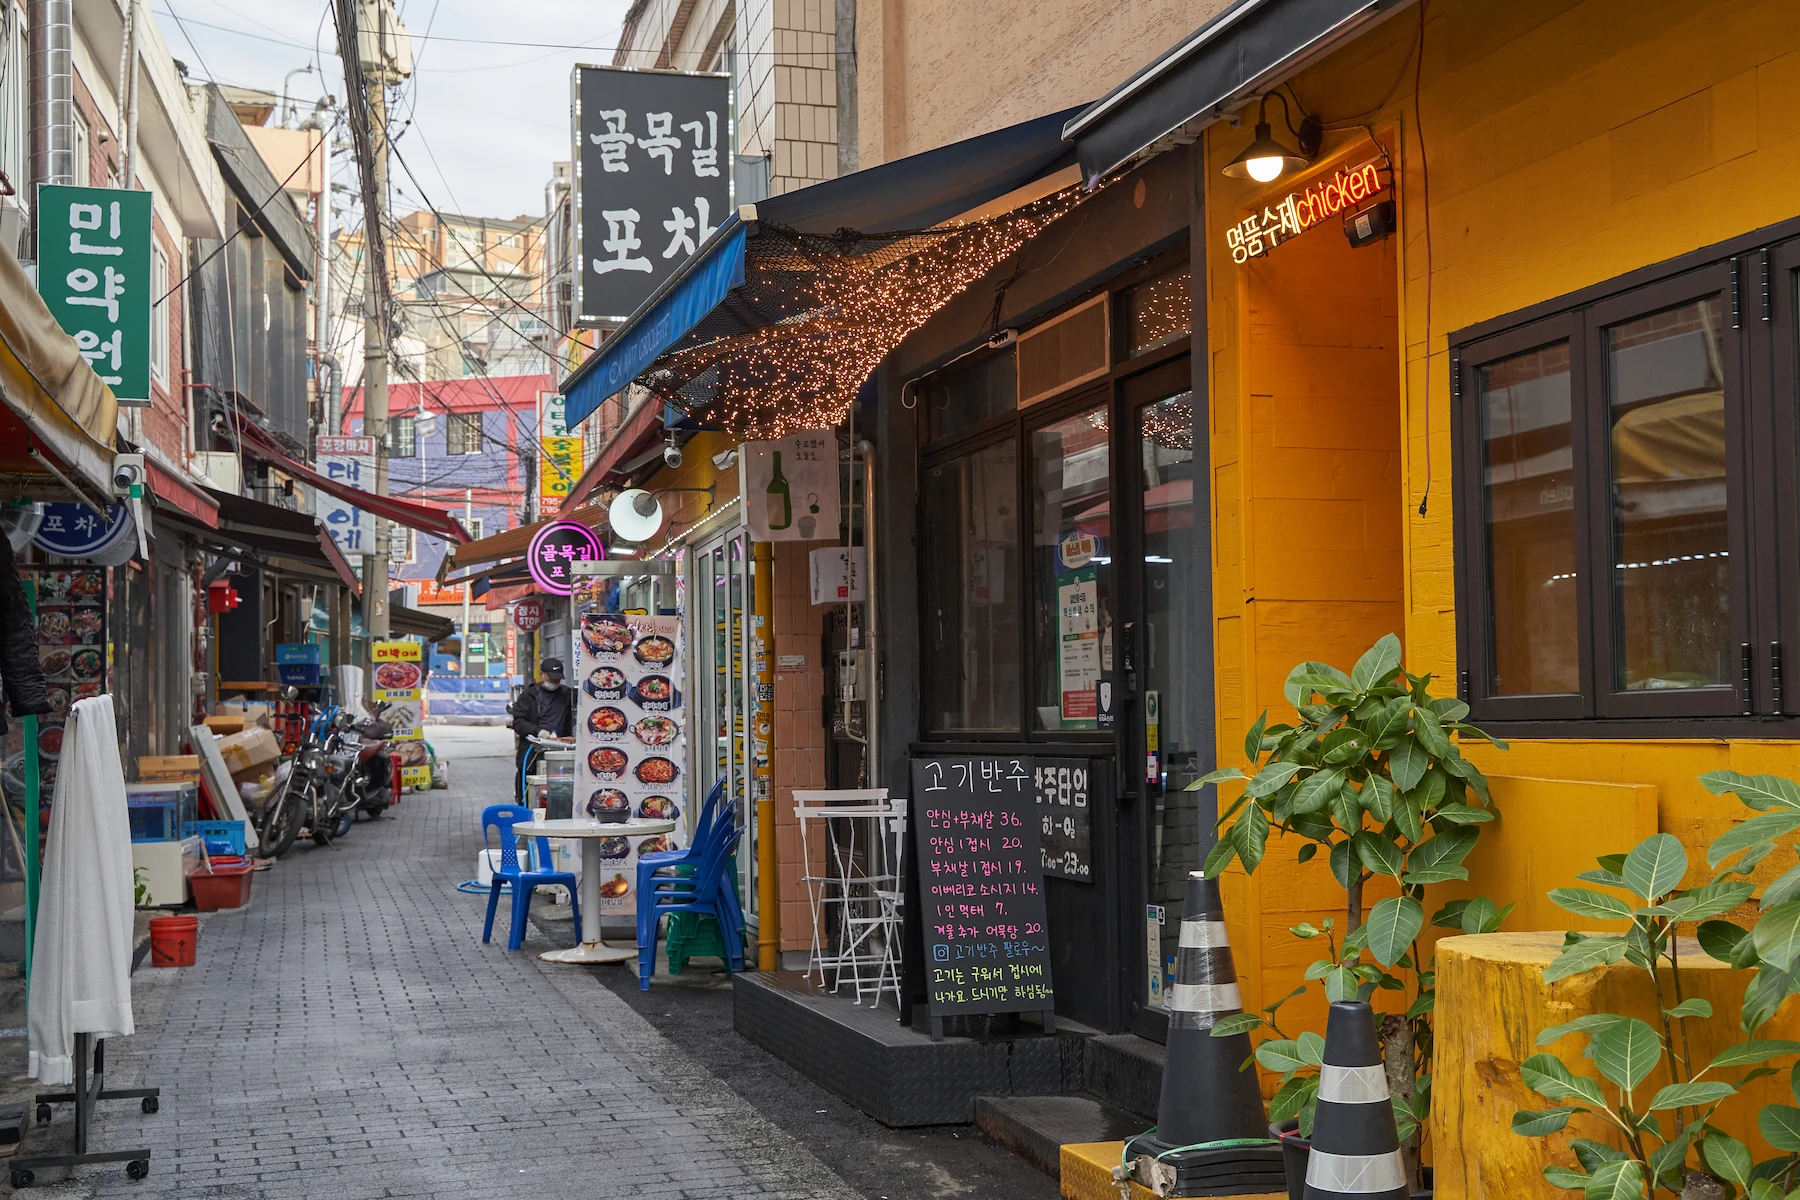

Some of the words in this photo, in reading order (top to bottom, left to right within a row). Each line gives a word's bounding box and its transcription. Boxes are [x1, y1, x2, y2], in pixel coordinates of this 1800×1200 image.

[590, 108, 720, 177] 골목길
[1226, 193, 1302, 264] 명품수제
[1297, 164, 1381, 227] chicken
[592, 197, 719, 274] 포차
[66, 201, 125, 386] 민약원
[321, 438, 370, 453] 포장마차
[794, 439, 825, 450] 수고했어
[43, 515, 97, 538] 포차
[540, 544, 592, 562] 골목길
[550, 565, 572, 578] 포
[518, 605, 540, 617] 정지
[518, 616, 540, 625] STOP
[392, 728, 414, 736] 추튀김
[925, 760, 1030, 793] 고기반주
[926, 809, 994, 830] 안심+부채살
[930, 837, 954, 855] 안심
[930, 860, 969, 878] 부채살
[931, 883, 977, 897] 이베리코
[980, 883, 1016, 897] 소시지
[959, 904, 985, 918] 먹태
[934, 924, 954, 940] 겨울
[957, 924, 979, 939] 추가
[986, 925, 1018, 940] 어묵탕
[955, 942, 999, 960] 고기반주
[933, 968, 966, 985] 고기는
[971, 966, 1003, 982] 구워서
[1008, 964, 1043, 980] 접시에
[971, 987, 1009, 1001] 드시기만
